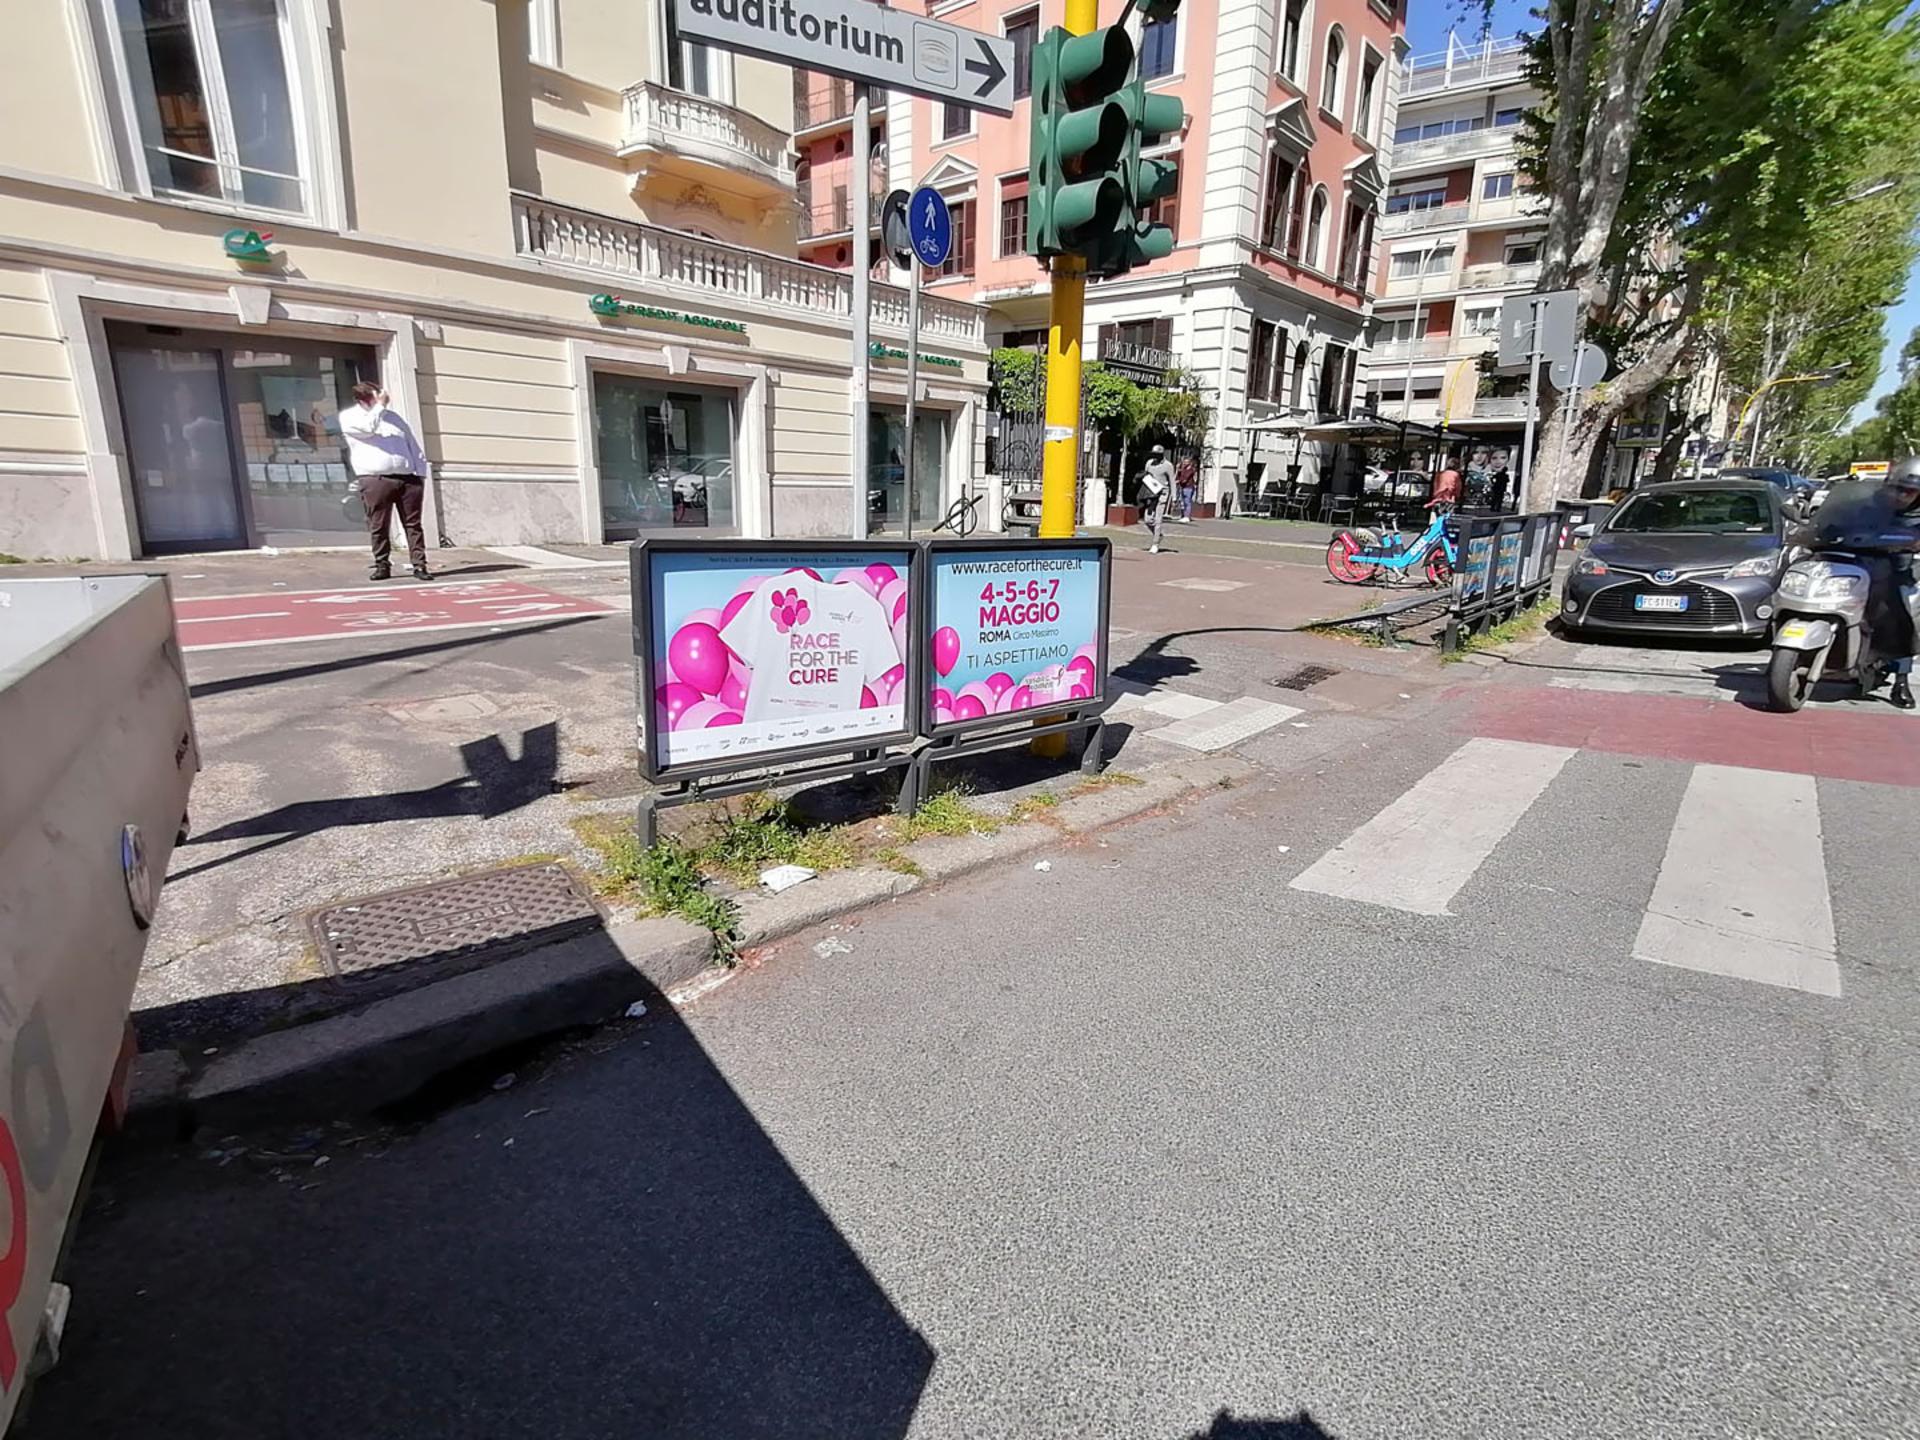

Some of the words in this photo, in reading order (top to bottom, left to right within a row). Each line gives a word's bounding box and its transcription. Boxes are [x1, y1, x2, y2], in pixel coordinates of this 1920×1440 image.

[690, 0, 904, 63] auditorium
[684, 314, 747, 333] AGRICOLE
[951, 558, 1082, 575] www.raceforthecure.it
[980, 579, 1060, 603] 4-5-6-7
[979, 602, 1060, 628] MAGGIO
[790, 632, 840, 650] RACE
[979, 629, 1011, 644] ROMA
[789, 651, 825, 668] FOR
[828, 650, 859, 666] THE
[967, 655, 979, 669] TI
[983, 644, 1068, 668] ASPETTIAMO
[788, 667, 839, 685] CURE
